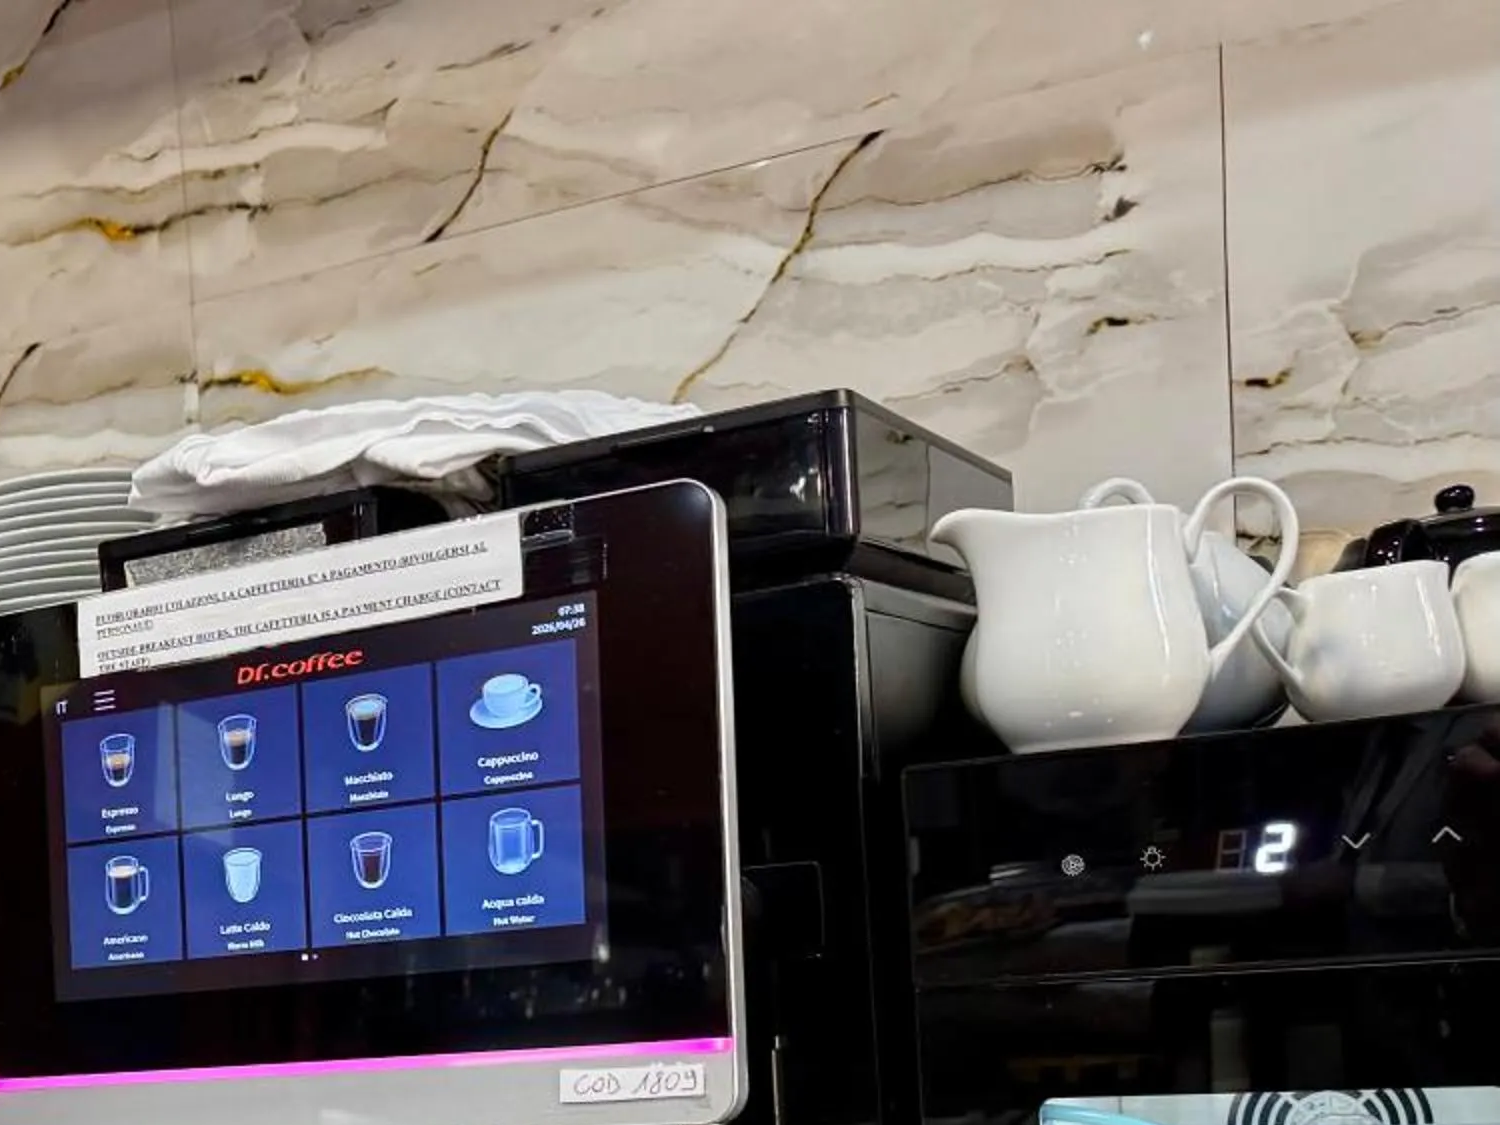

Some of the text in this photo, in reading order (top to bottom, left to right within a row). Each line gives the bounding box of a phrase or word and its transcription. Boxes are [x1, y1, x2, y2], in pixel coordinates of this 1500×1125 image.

[328, 557, 396, 579] PAGAMENTO
[139, 635, 192, 654] BREAKFAST
[234, 623, 253, 636] THE
[340, 598, 390, 617] PAYMENT
[394, 589, 440, 608] CHARGE
[237, 648, 364, 685] Dr.coffee
[55, 699, 69, 715] IT
[477, 751, 539, 769] Cappuccino
[344, 771, 394, 786] Macchiato
[225, 790, 255, 803] Lungo
[101, 805, 139, 819] Espresso
[1255, 822, 1297, 874] 2
[481, 893, 545, 912] Acqua calda
[103, 933, 149, 946] Americano
